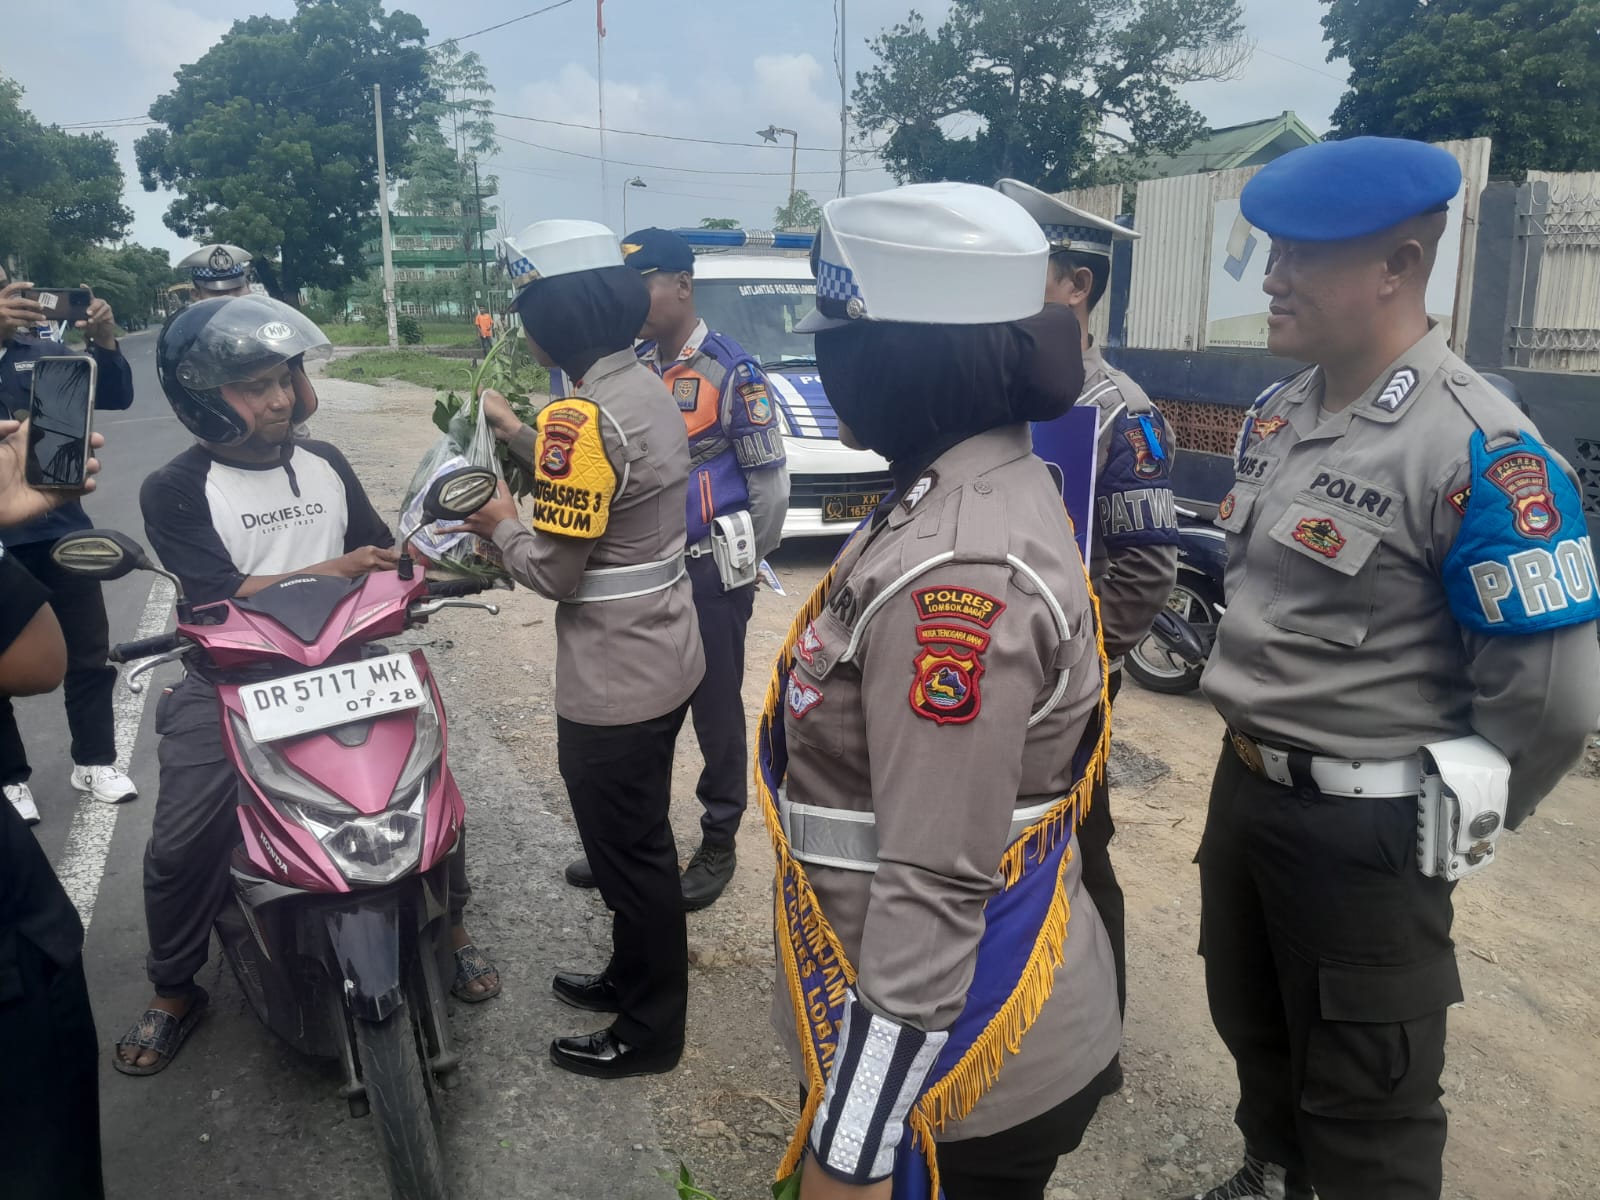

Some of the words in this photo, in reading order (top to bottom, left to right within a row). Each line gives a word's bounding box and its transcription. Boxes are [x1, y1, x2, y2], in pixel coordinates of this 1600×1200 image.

[593, 491, 602, 513] 3
[1310, 472, 1392, 517] POLRI
[280, 577, 318, 588] HONDA
[924, 590, 994, 612] POLRES
[928, 602, 962, 613] LOMBOK
[253, 686, 289, 711] DR
[293, 668, 357, 702] 5717
[368, 659, 407, 685] MK
[260, 831, 289, 876] HONDA
[801, 911, 847, 1009] RINJANI
